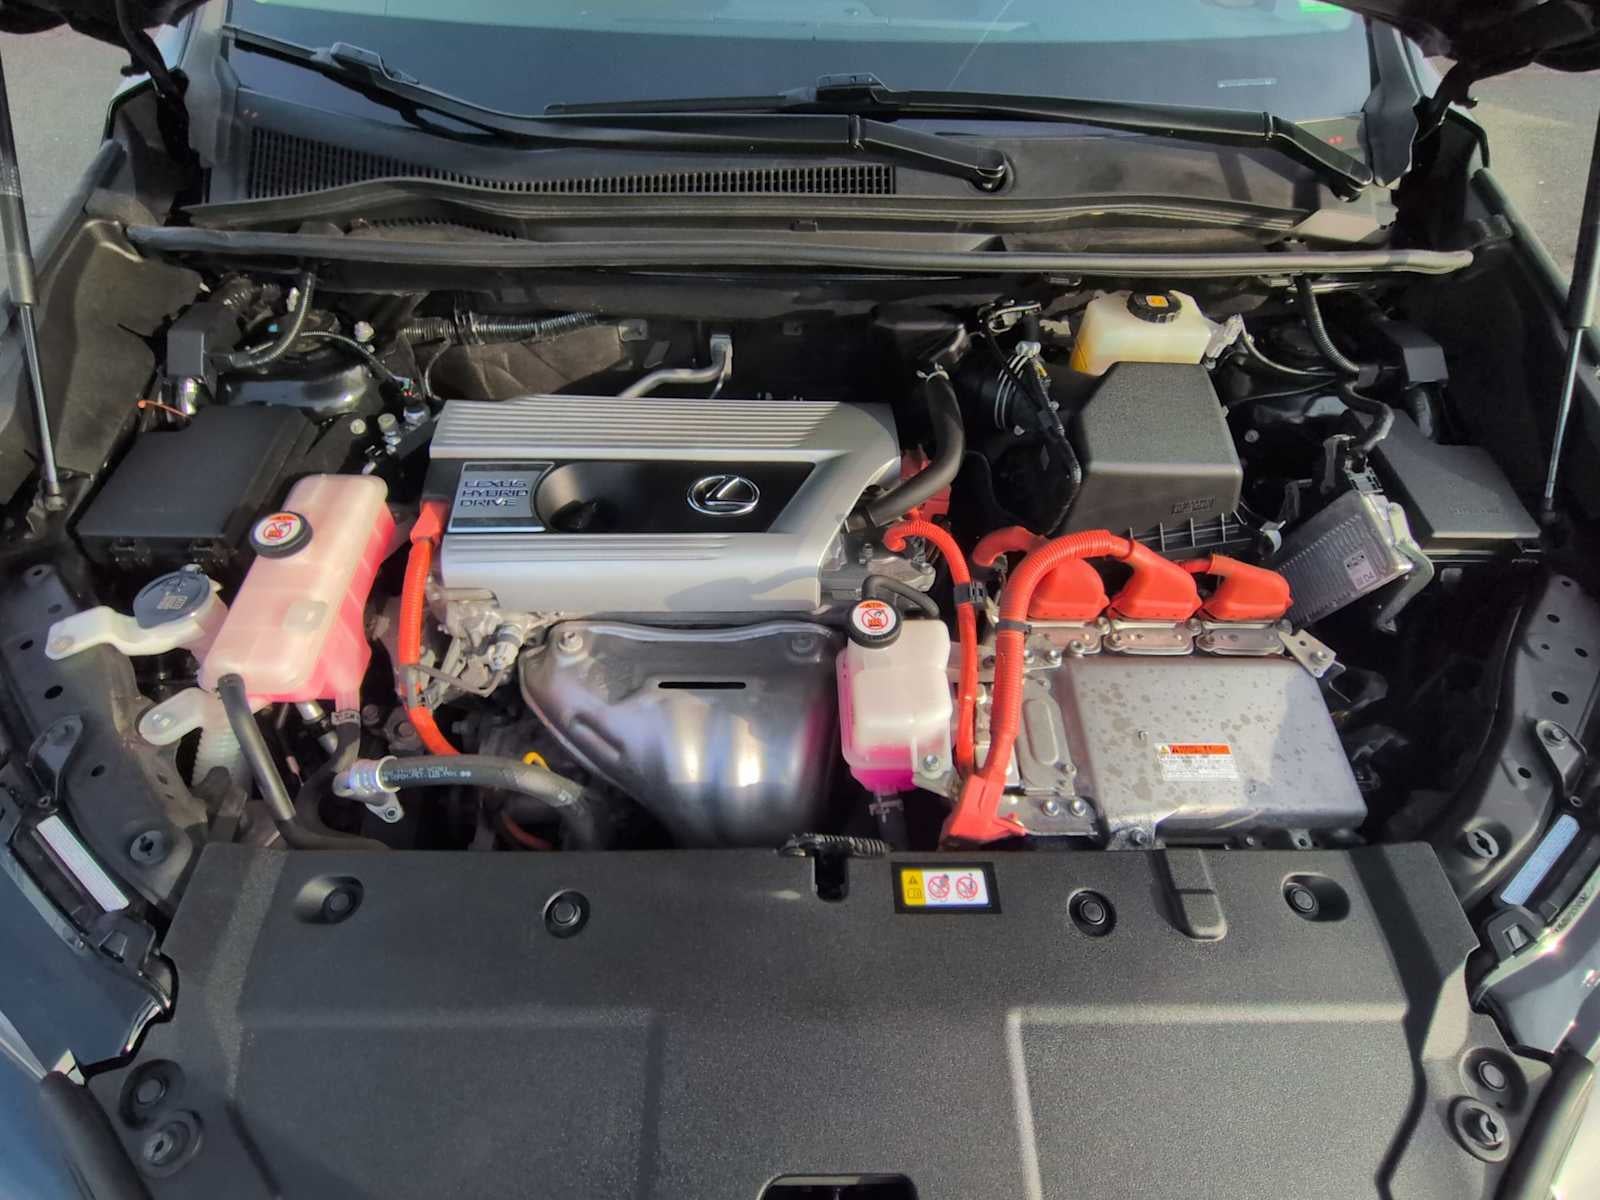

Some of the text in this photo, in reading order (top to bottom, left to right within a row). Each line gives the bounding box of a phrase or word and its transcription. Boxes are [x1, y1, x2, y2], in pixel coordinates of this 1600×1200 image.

[464, 479, 527, 488] LEXUS
[462, 489, 529, 497] HYBRID
[460, 498, 517, 507] DRIVE
